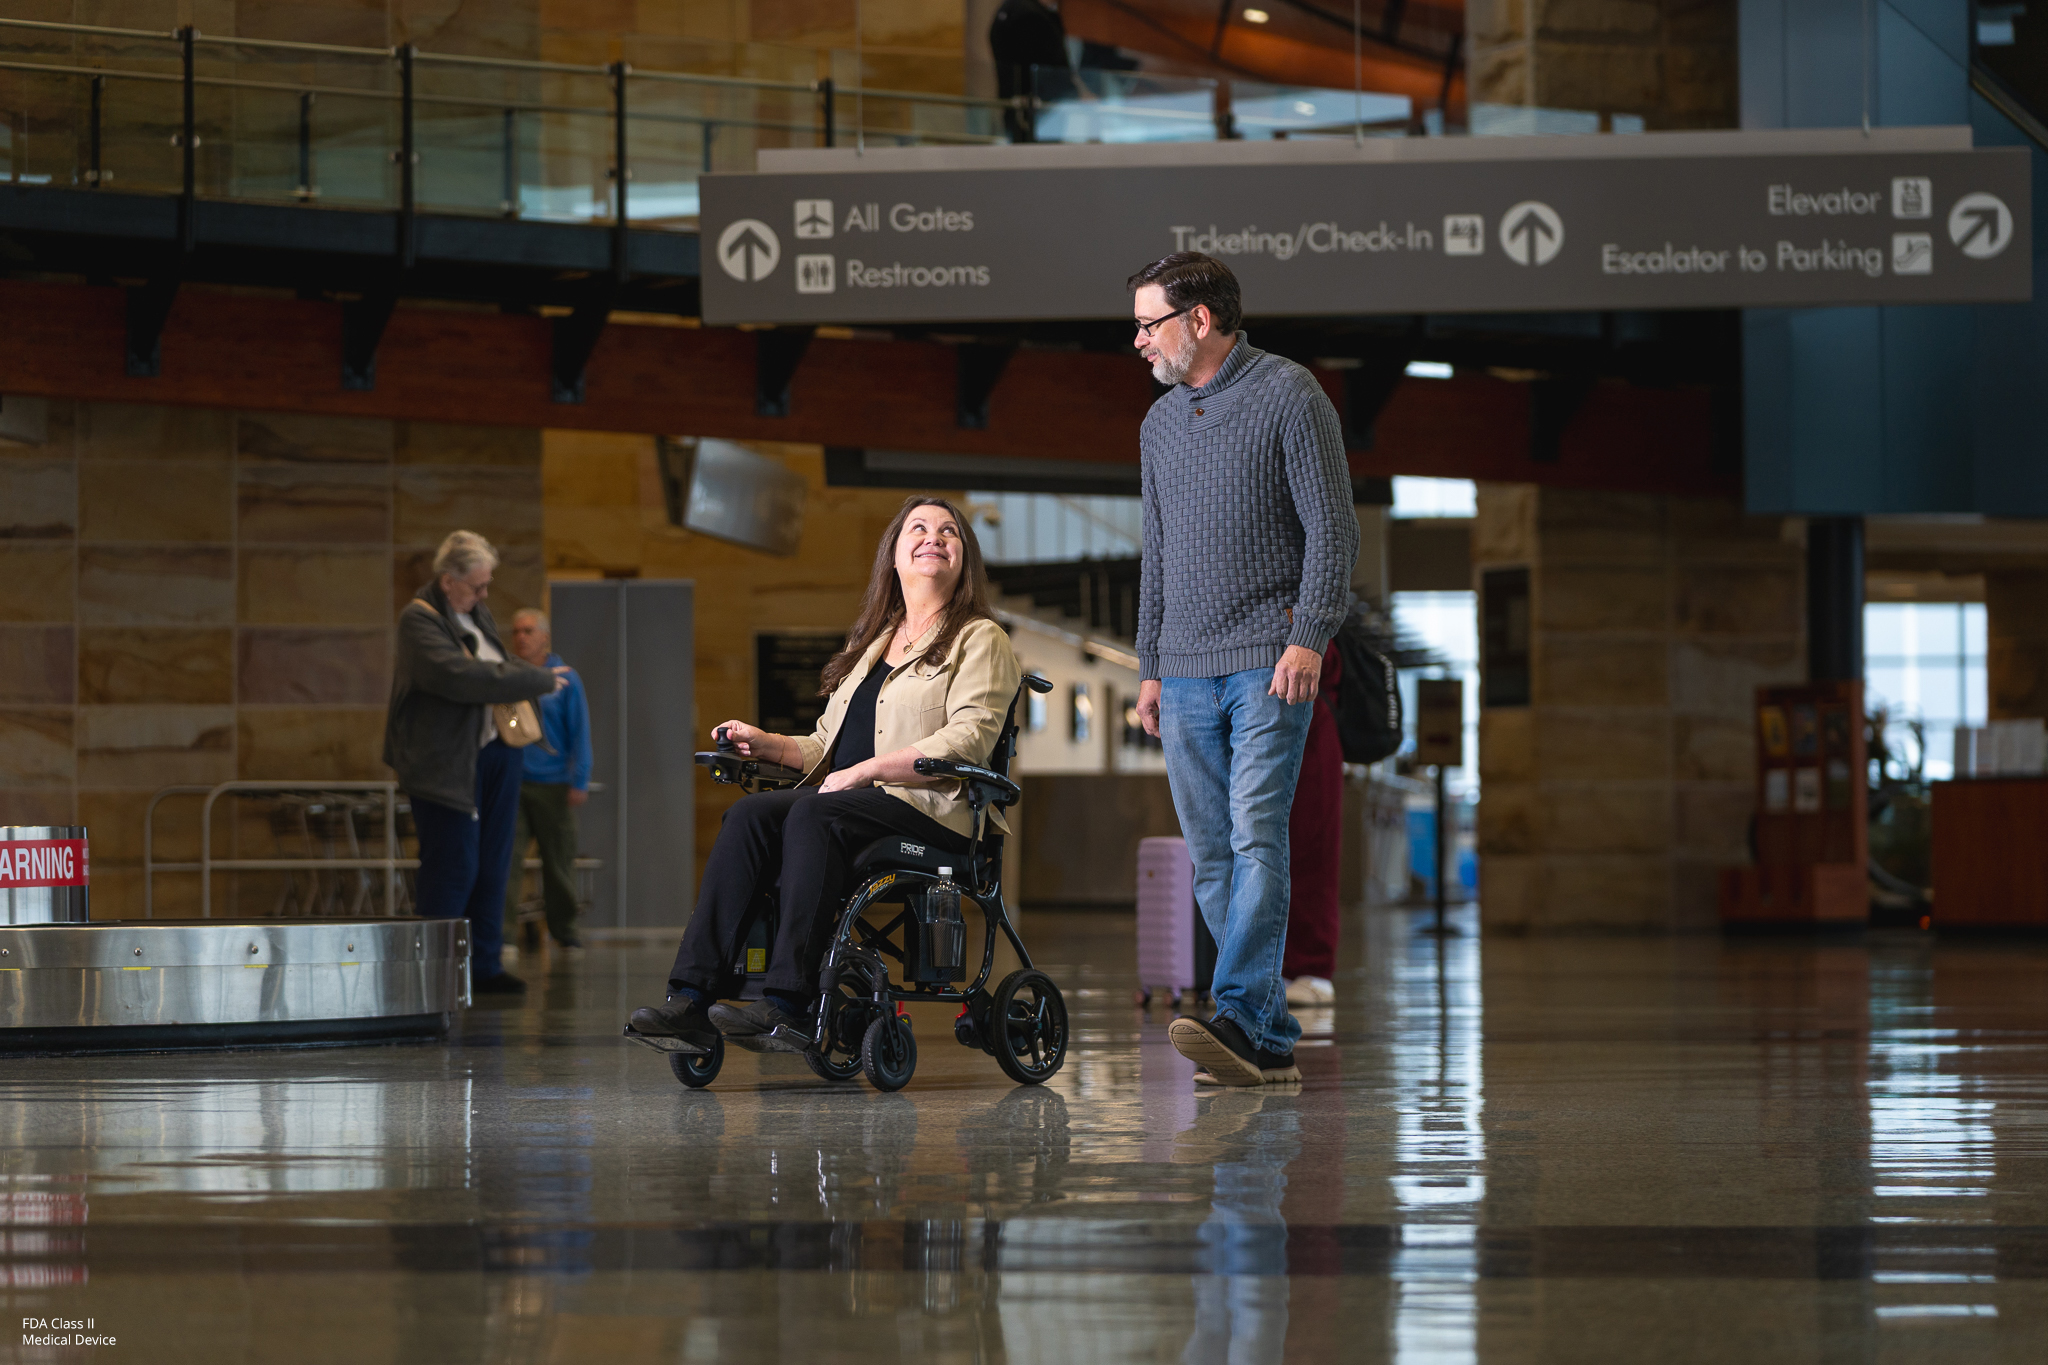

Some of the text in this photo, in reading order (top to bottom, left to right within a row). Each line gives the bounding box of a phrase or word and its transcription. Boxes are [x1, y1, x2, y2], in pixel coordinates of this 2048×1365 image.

[1768, 183, 1881, 215] Elevator
[843, 202, 975, 233] All Gates
[1169, 221, 1433, 260] Ticketing/Check-In
[846, 258, 991, 288] Restrooms
[1601, 239, 1883, 277] Escalator to Parking
[0, 846, 74, 880] ARNING
[867, 873, 896, 898] Jazzy
